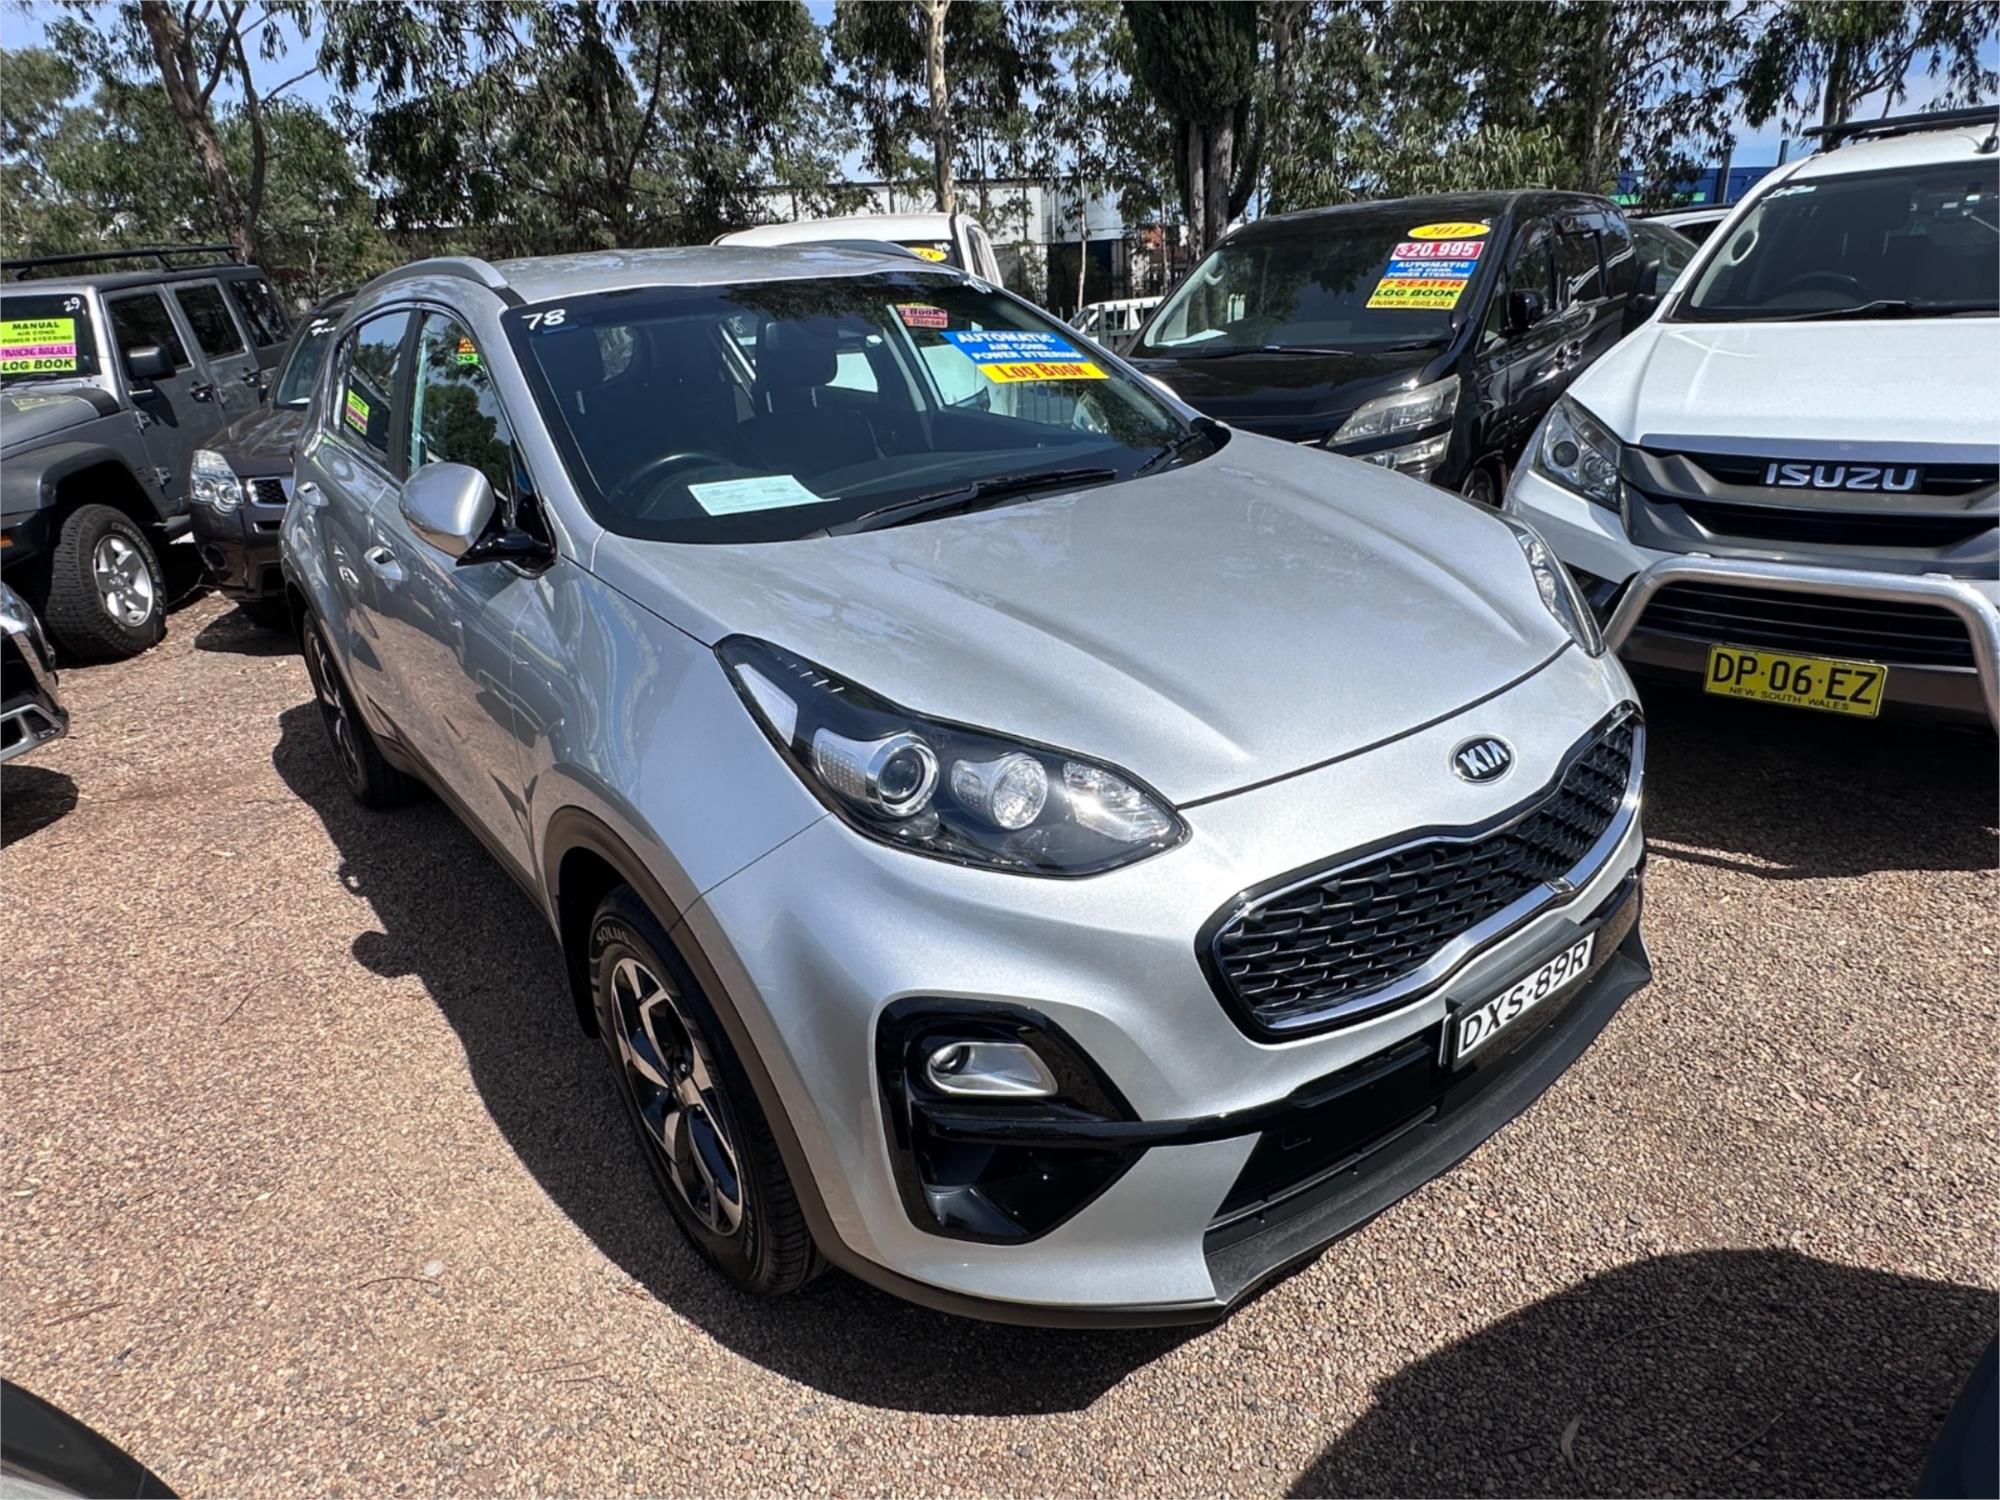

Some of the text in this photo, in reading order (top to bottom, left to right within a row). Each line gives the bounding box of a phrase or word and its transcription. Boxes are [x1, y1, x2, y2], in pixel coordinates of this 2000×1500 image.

[1396, 279, 1464, 288] SEATER
[1375, 289, 1458, 297] LOG BOOK
[63, 297, 80, 312] 29
[12, 321, 60, 330] MANUAL
[521, 308, 566, 331] 78
[957, 333, 1055, 343] AUTOMATIC
[971, 351, 1084, 360] POWER STEERING
[2, 359, 73, 371] LOG BOOK
[994, 362, 1089, 379] Log Book
[1765, 463, 1917, 491] ISUZU
[1729, 686, 1849, 711] NEW SOUTH WALES
[1458, 740, 1509, 777] KIA
[596, 926, 630, 946] SOLUS
